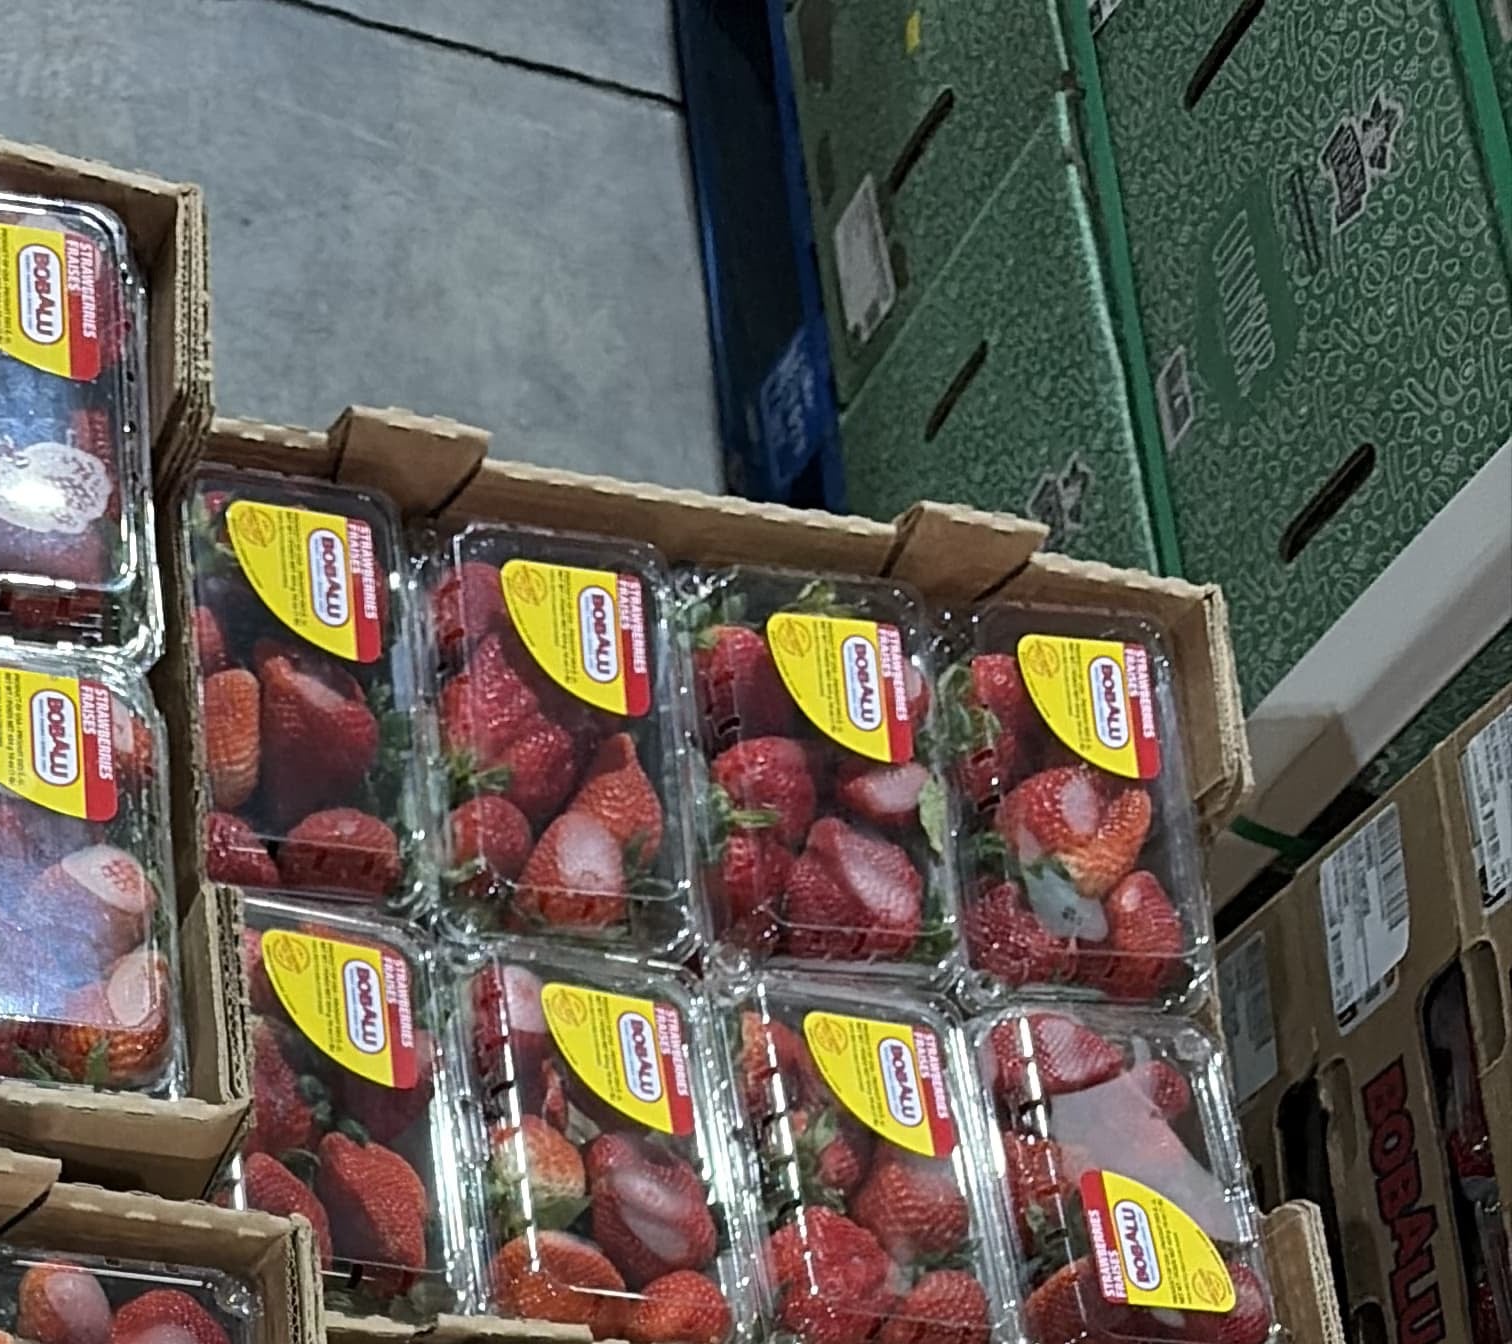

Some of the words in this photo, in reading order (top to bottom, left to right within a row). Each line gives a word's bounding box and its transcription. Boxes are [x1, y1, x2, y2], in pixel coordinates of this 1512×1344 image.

[32, 252, 54, 336] BOBALU
[320, 536, 341, 619] BOBALU
[590, 593, 610, 675] BOBALU
[853, 642, 874, 723] BOBALU
[1099, 663, 1121, 741] BOBALU
[46, 696, 69, 778] BOBALU
[355, 966, 377, 1046] BOBALU
[629, 1018, 655, 1096] BOBALU
[889, 1044, 915, 1119] BOBALU
[1121, 1207, 1150, 1283] BOBALU
